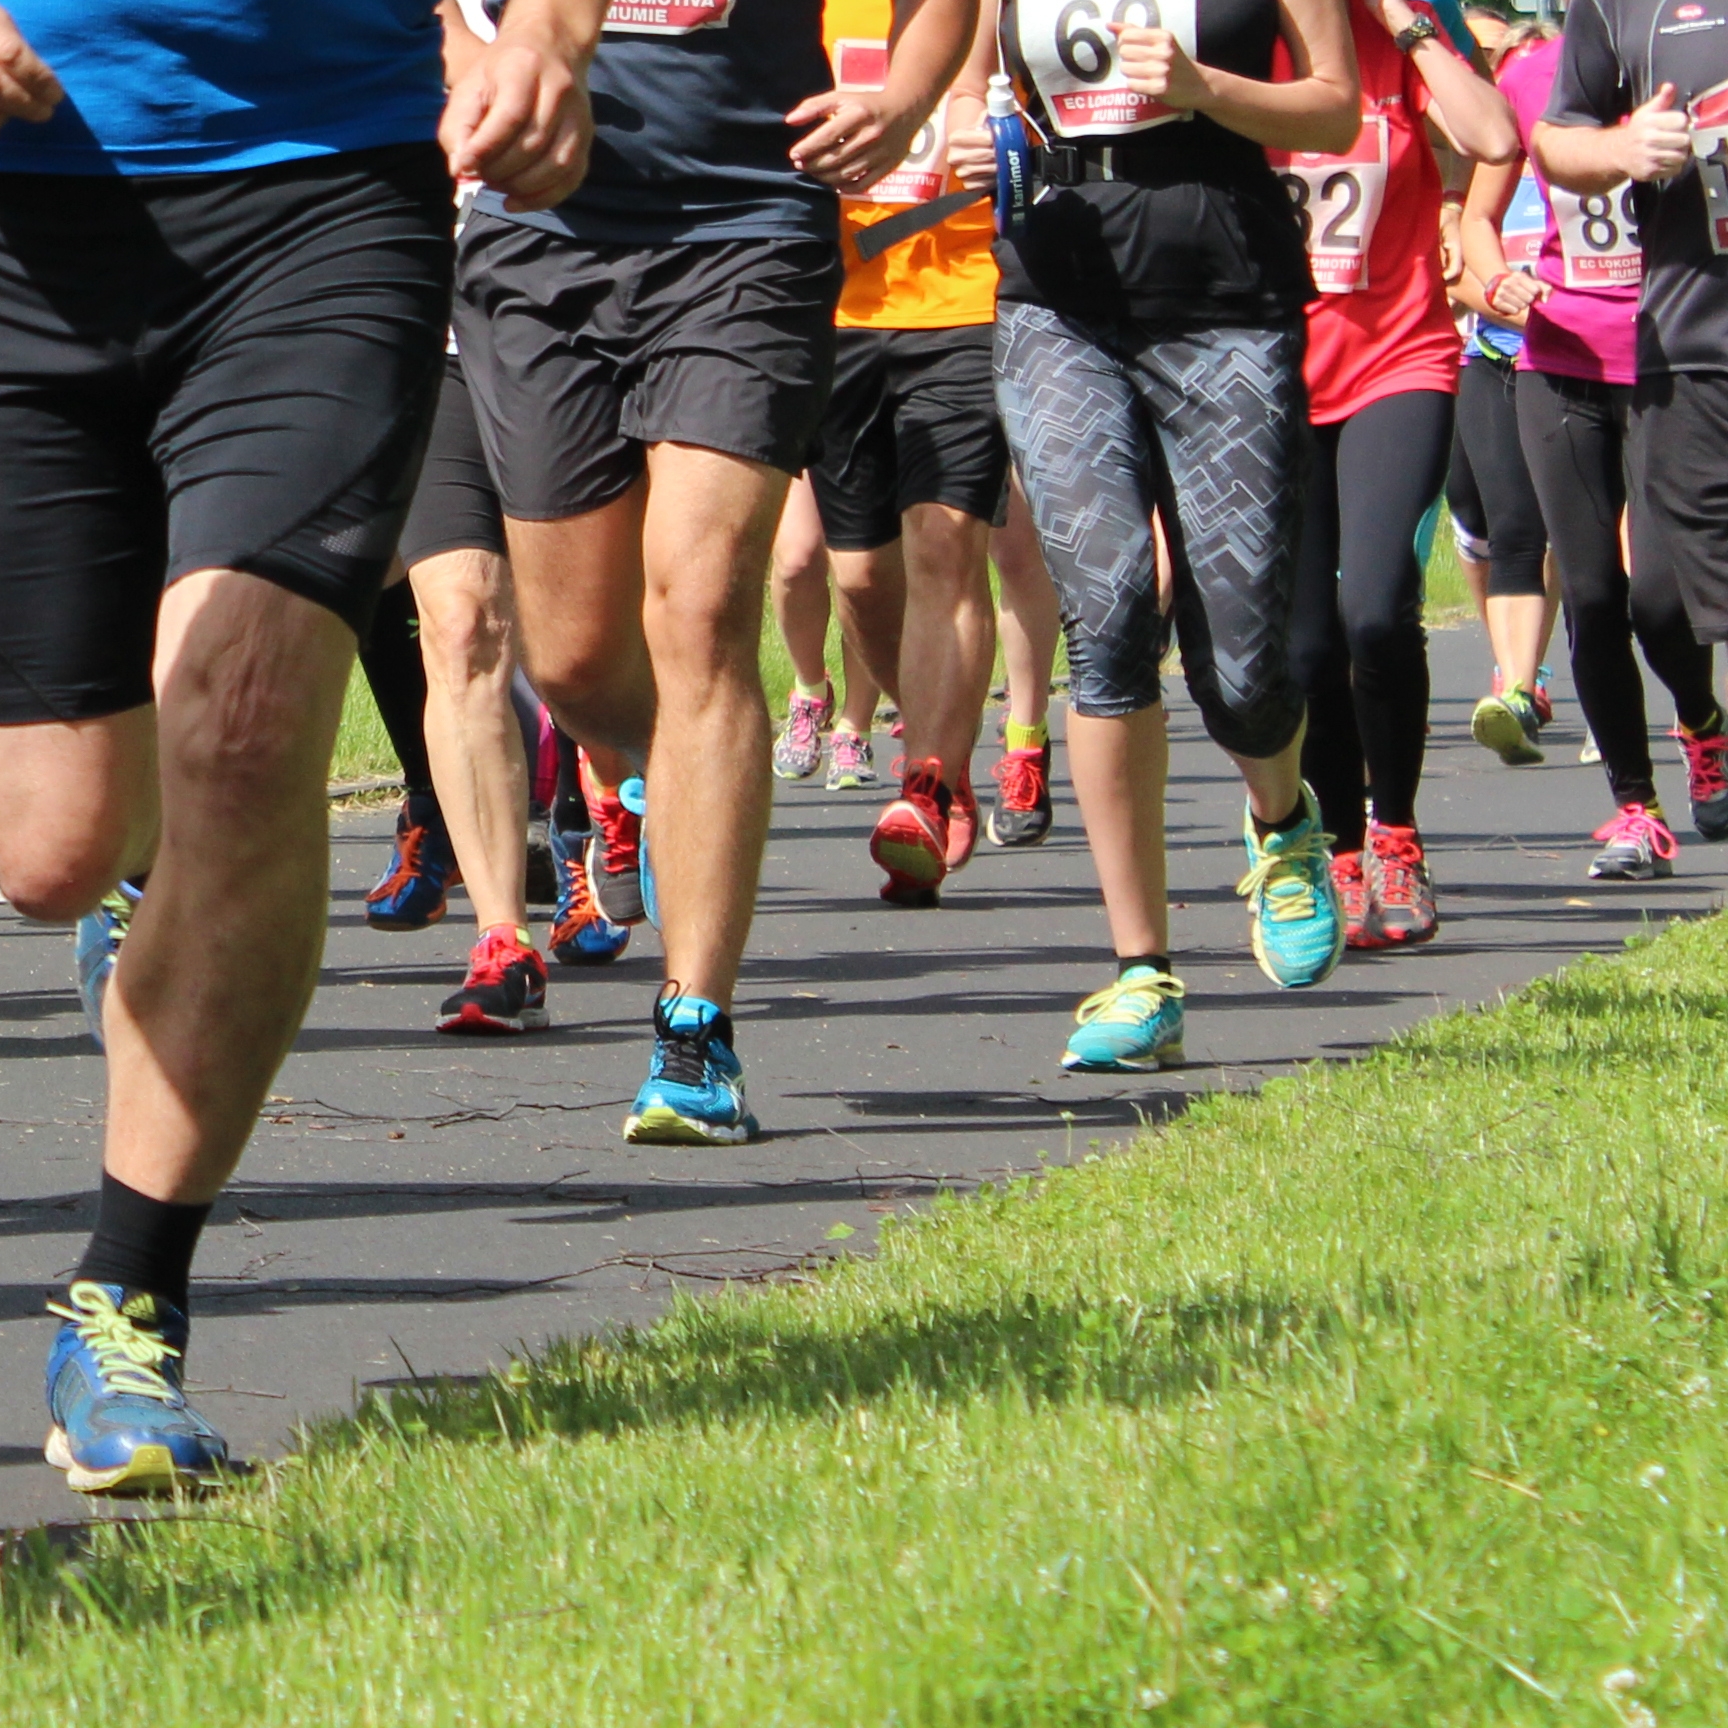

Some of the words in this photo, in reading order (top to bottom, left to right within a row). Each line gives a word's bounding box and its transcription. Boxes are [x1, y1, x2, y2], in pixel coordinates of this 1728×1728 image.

[1063, 96, 1085, 110] EC
[1007, 149, 1024, 208] karrimor
[1579, 258, 1597, 270] EC
